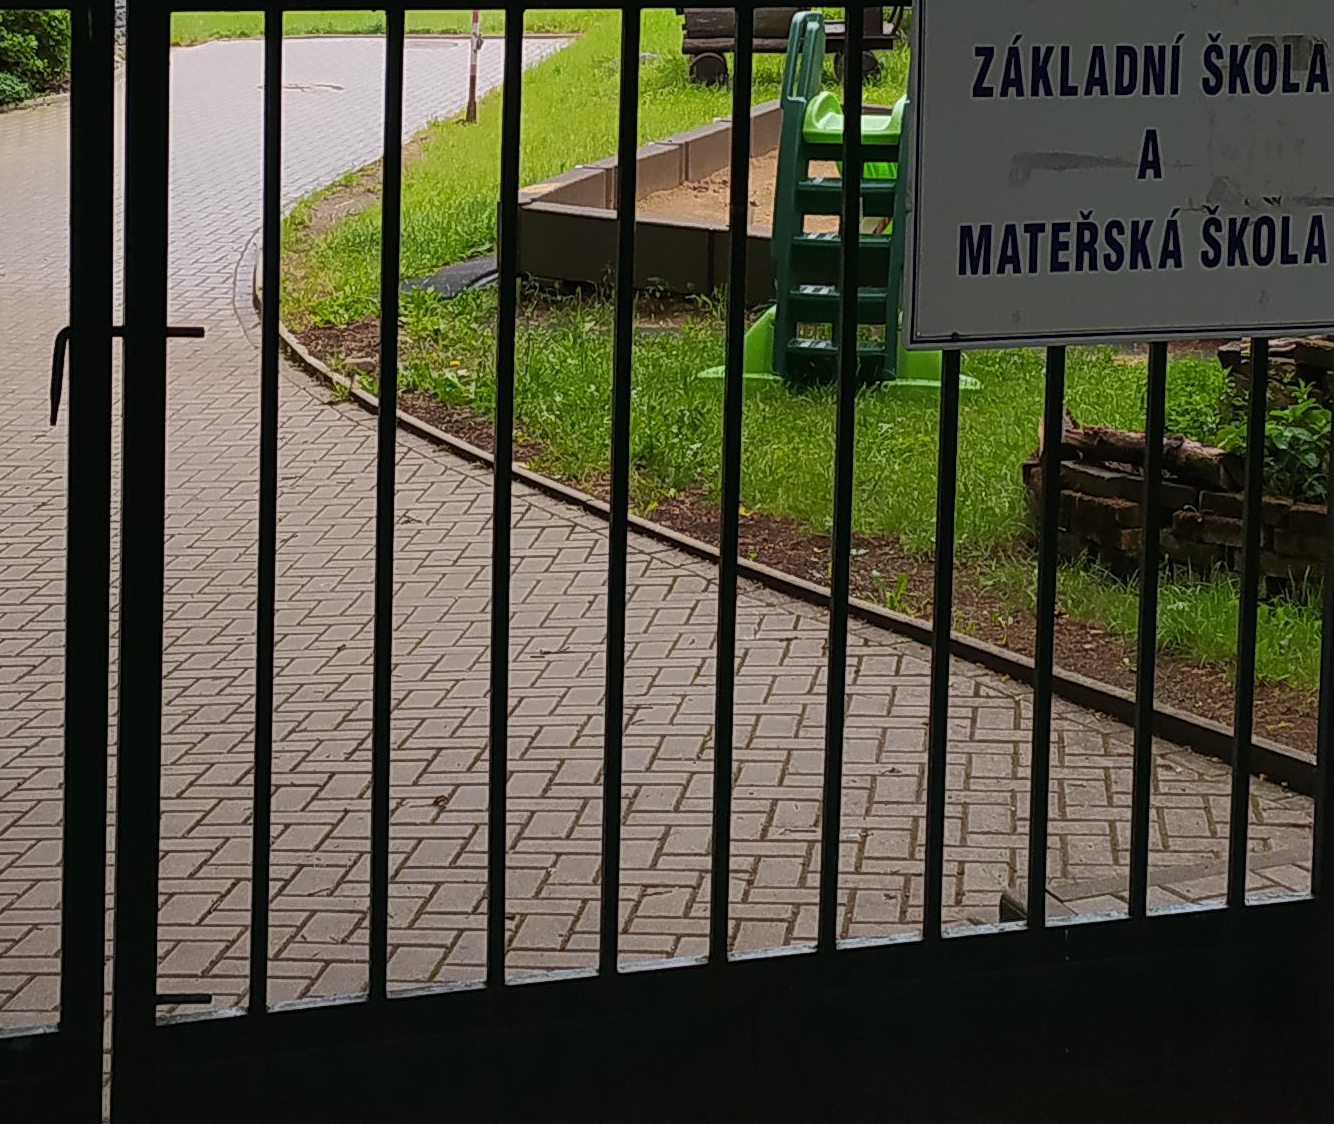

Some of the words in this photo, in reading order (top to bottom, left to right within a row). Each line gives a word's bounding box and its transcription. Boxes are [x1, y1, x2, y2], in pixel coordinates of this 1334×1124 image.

[971, 34, 1186, 99] ZÁKLADNÍ
[1201, 32, 1330, 97] ŠKOLA
[1136, 129, 1163, 180] A
[957, 207, 1183, 277] MATEŘSKÁ
[1200, 205, 1328, 270] ŠKOLA
